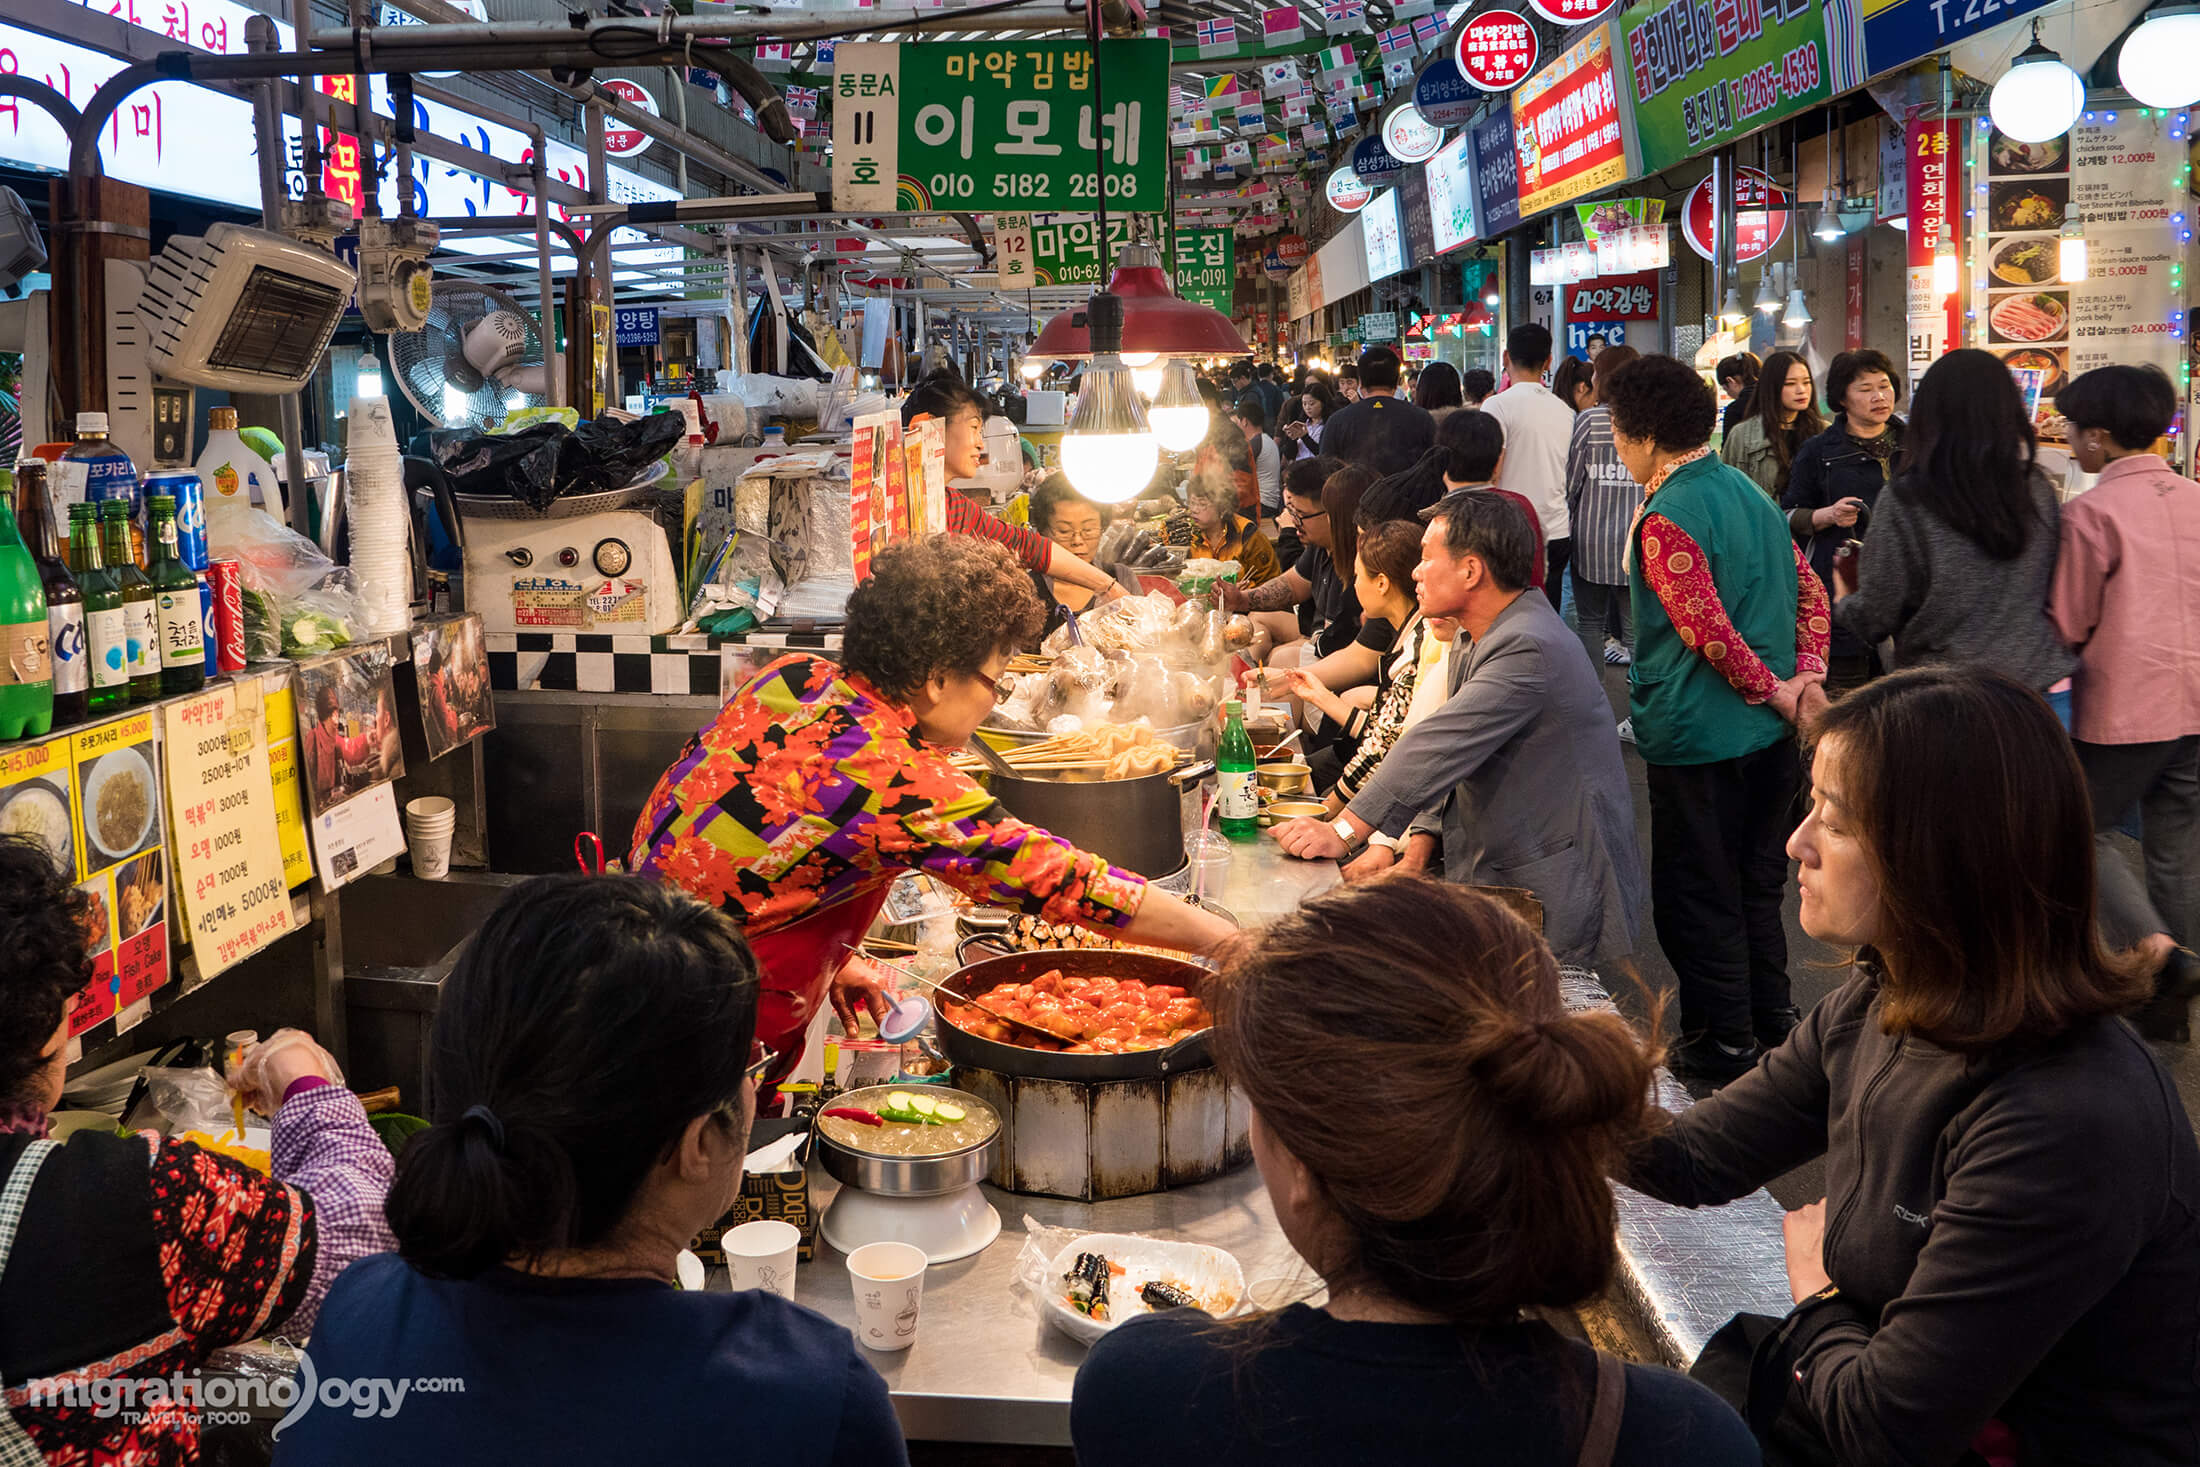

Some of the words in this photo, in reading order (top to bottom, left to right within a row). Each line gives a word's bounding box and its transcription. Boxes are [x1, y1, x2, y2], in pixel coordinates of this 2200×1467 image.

[946, 50, 1096, 91] 마약김밥
[838, 73, 896, 98] 동문A
[849, 157, 881, 185] 호
[930, 174, 975, 198] 010
[992, 173, 1051, 198] 5182
[1069, 173, 1138, 199] 2808
[1003, 236, 1026, 254] 12
[1007, 260, 1025, 276] 호
[1572, 285, 1653, 314] 마약김밥
[181, 697, 225, 726] 마약김밥
[219, 788, 250, 813] 3000원
